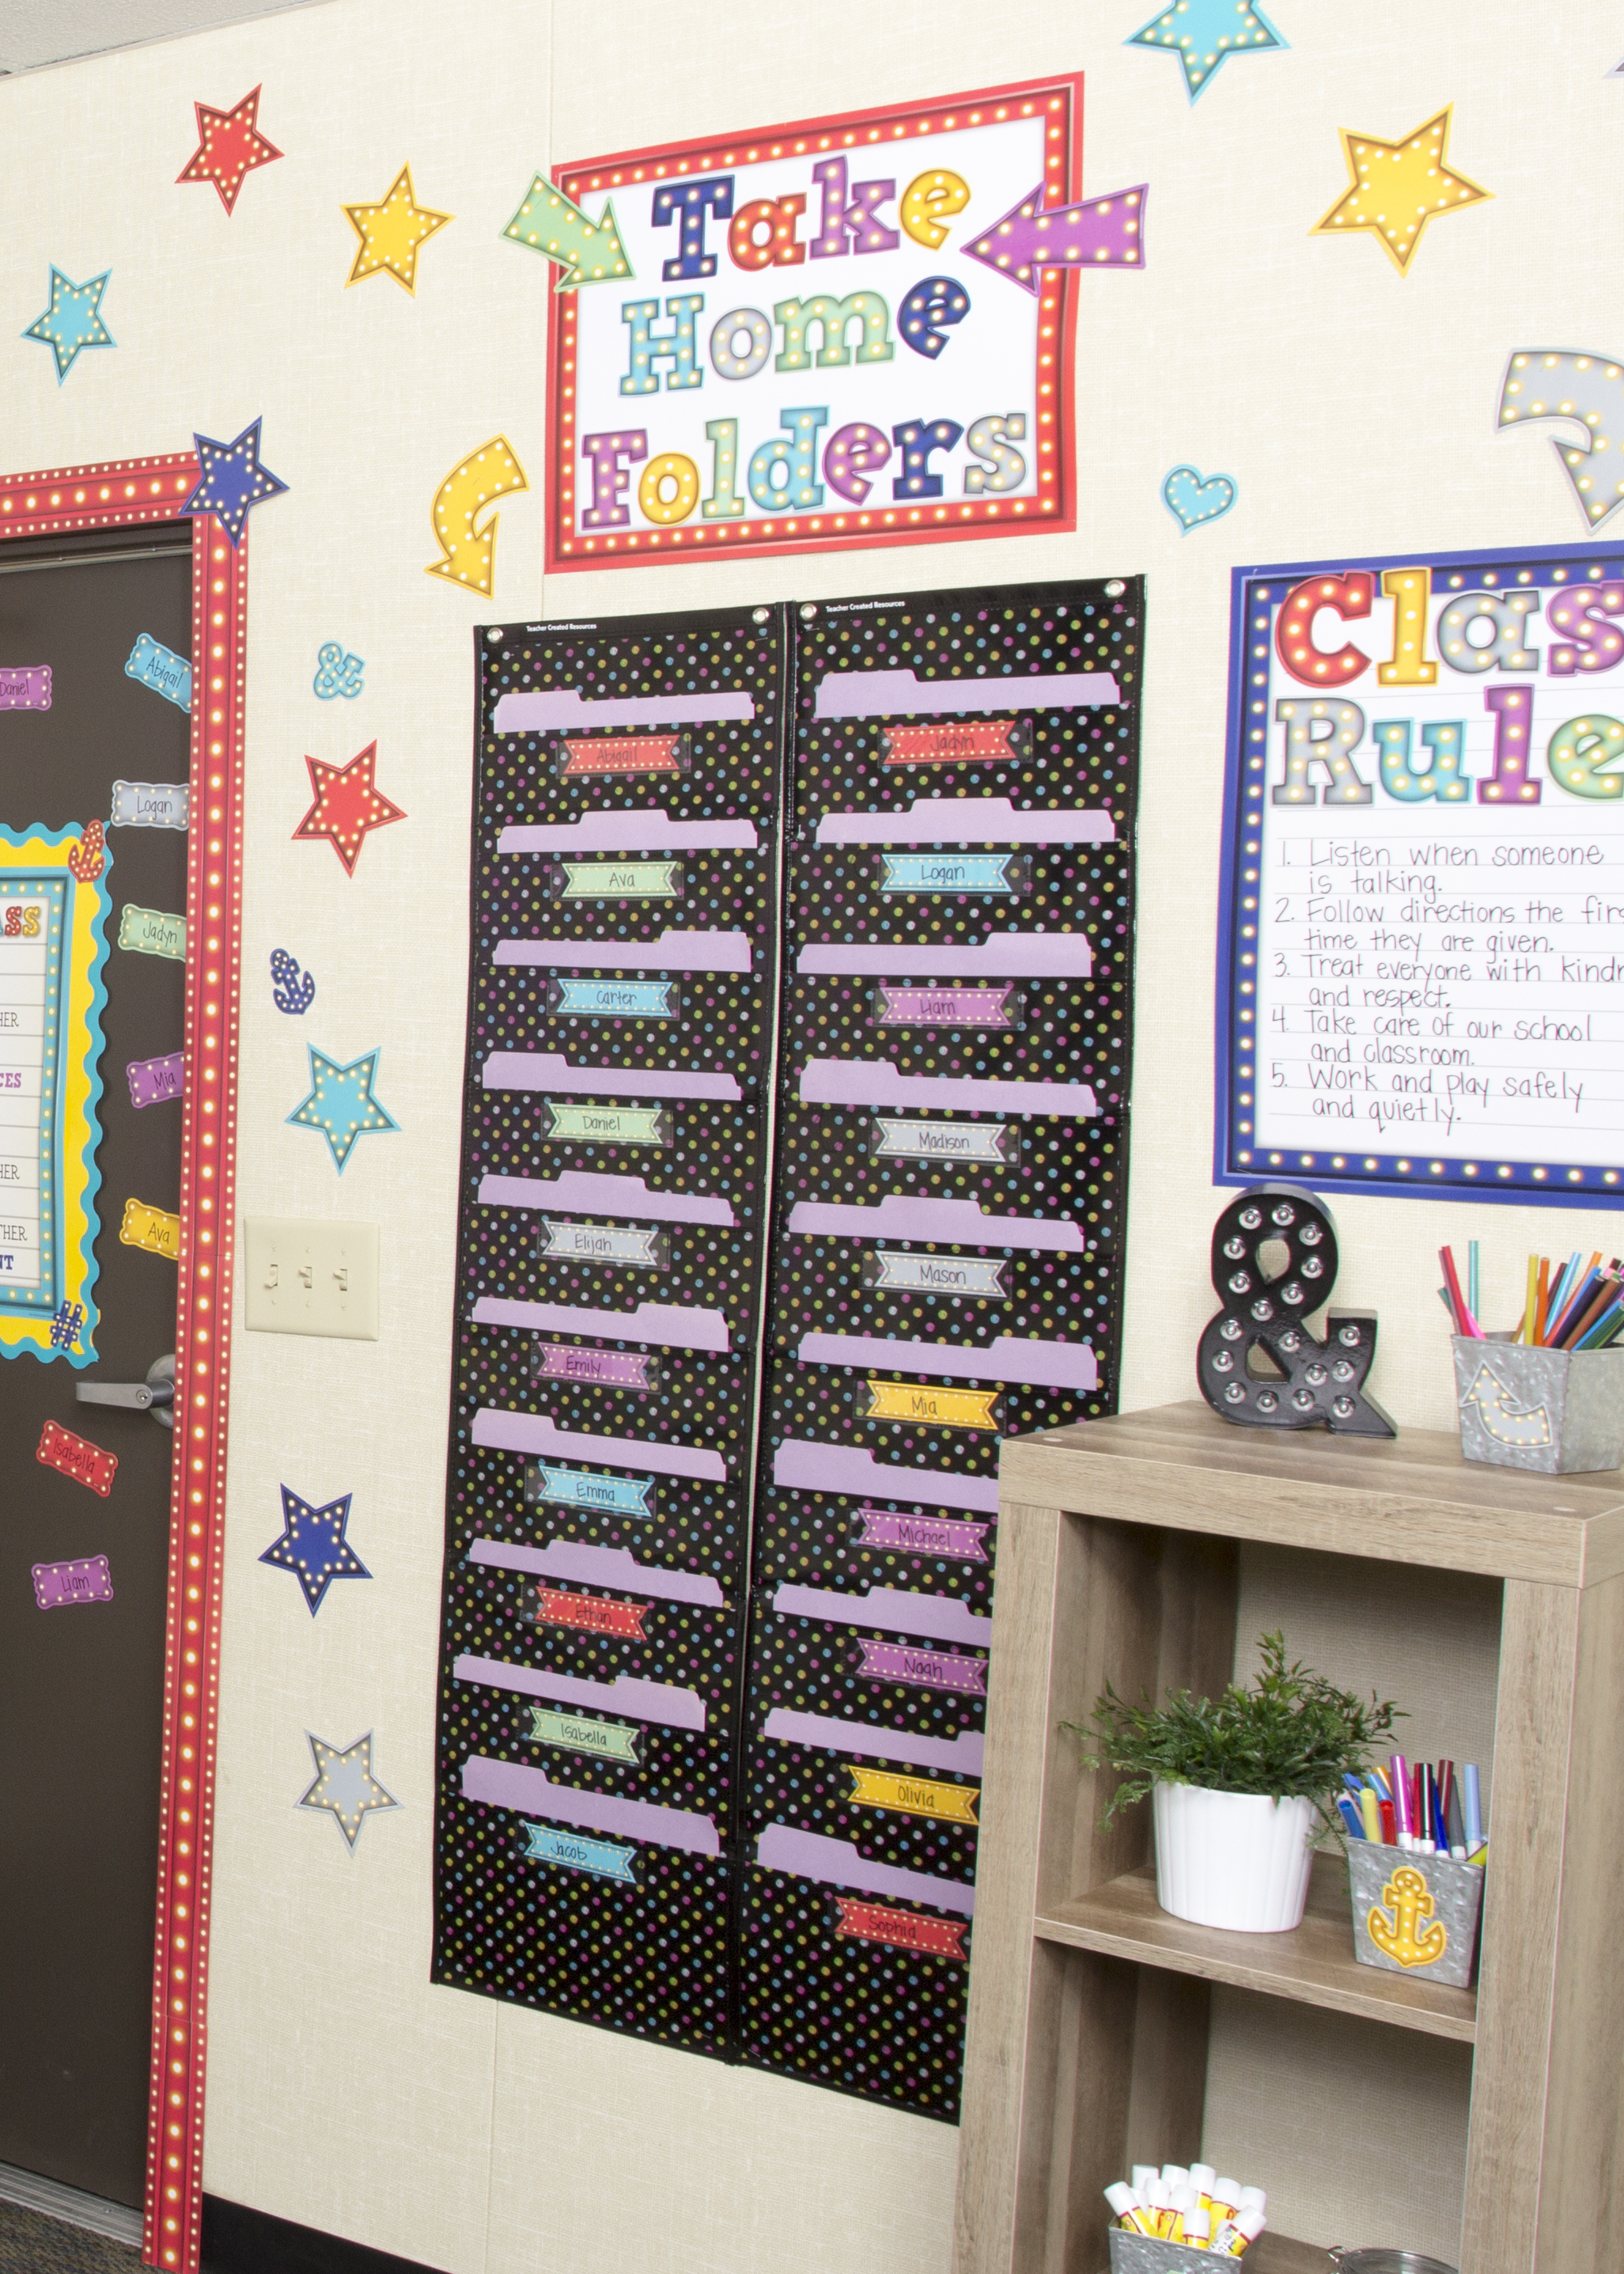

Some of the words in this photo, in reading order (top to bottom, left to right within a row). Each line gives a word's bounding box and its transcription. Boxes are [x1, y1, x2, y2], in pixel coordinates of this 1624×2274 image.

[652, 154, 971, 282] Take
[619, 275, 971, 396] Home
[581, 405, 1027, 530] Folders
[825, 605, 849, 613] Teacher
[849, 601, 873, 611] Created
[1274, 566, 1624, 689] Clas
[146, 656, 184, 689] Abigail
[0, 679, 29, 696] Daniel
[929, 733, 975, 752] Jadyn
[1270, 683, 1624, 807] Rule
[596, 745, 638, 767] Abigail
[137, 795, 172, 821] Logan
[1282, 840, 1291, 866] 1.
[1309, 839, 1391, 866] Listen
[1410, 843, 1478, 866] when
[1492, 843, 1604, 866] someone
[608, 872, 636, 888] Ava
[921, 864, 965, 884] Logan
[1308, 871, 1332, 894] is
[1351, 870, 1442, 904] talking.
[0, 905, 40, 937] SS
[1274, 897, 1295, 923] 2.
[1307, 897, 1384, 923] Follow
[1401, 898, 1515, 923] directions
[1525, 900, 1563, 923] the
[142, 921, 177, 948] Jadyn
[1304, 928, 1357, 950] time
[1370, 929, 1421, 961] they
[1441, 934, 1474, 952] are
[1487, 930, 1554, 964] given.
[1274, 953, 1290, 977] 3.
[1301, 953, 1364, 978] Treat
[1377, 960, 1471, 992] everyone
[1487, 957, 1541, 982] with
[596, 989, 637, 1006] Carter
[920, 999, 956, 1014] Liam
[1309, 985, 1350, 1006] and
[1364, 985, 1452, 1016] respect.
[1271, 1006, 1289, 1033] 4.
[1304, 1009, 1357, 1034] Take
[1373, 1015, 1420, 1036] care
[1433, 1012, 1453, 1036] of
[1467, 1021, 1502, 1038] our
[1514, 1014, 1592, 1041] school
[1311, 1040, 1351, 1063] and
[1364, 1037, 1475, 1066] classroom.
[153, 1071, 176, 1090] Mia
[1271, 1063, 1289, 1088] 5.
[1308, 1063, 1377, 1091] Work
[1391, 1068, 1433, 1093] and
[1447, 1071, 1490, 1108] play
[1503, 1071, 1583, 1113] safely
[582, 1115, 621, 1131] Daniel
[1312, 1095, 1355, 1119] and
[1368, 1097, 1461, 1136] quietly.
[919, 1132, 970, 1150] Madison
[148, 1222, 170, 1245] Ava
[575, 1234, 612, 1254] Elijah
[920, 1264, 966, 1285] Mason
[566, 1355, 602, 1380] Emily
[911, 1397, 937, 1416] Mia
[53, 1438, 96, 1474] Isabella
[576, 1482, 615, 1502] Emma
[899, 1524, 951, 1547] Michael
[61, 1575, 90, 1592] Liam
[576, 1604, 611, 1624] Ethan
[904, 1658, 943, 1680] Noah
[561, 1723, 607, 1746] Isabella
[897, 1786, 935, 1808] Olivia
[550, 1841, 588, 1860] Jacob
[869, 1916, 917, 1939] Sophia
